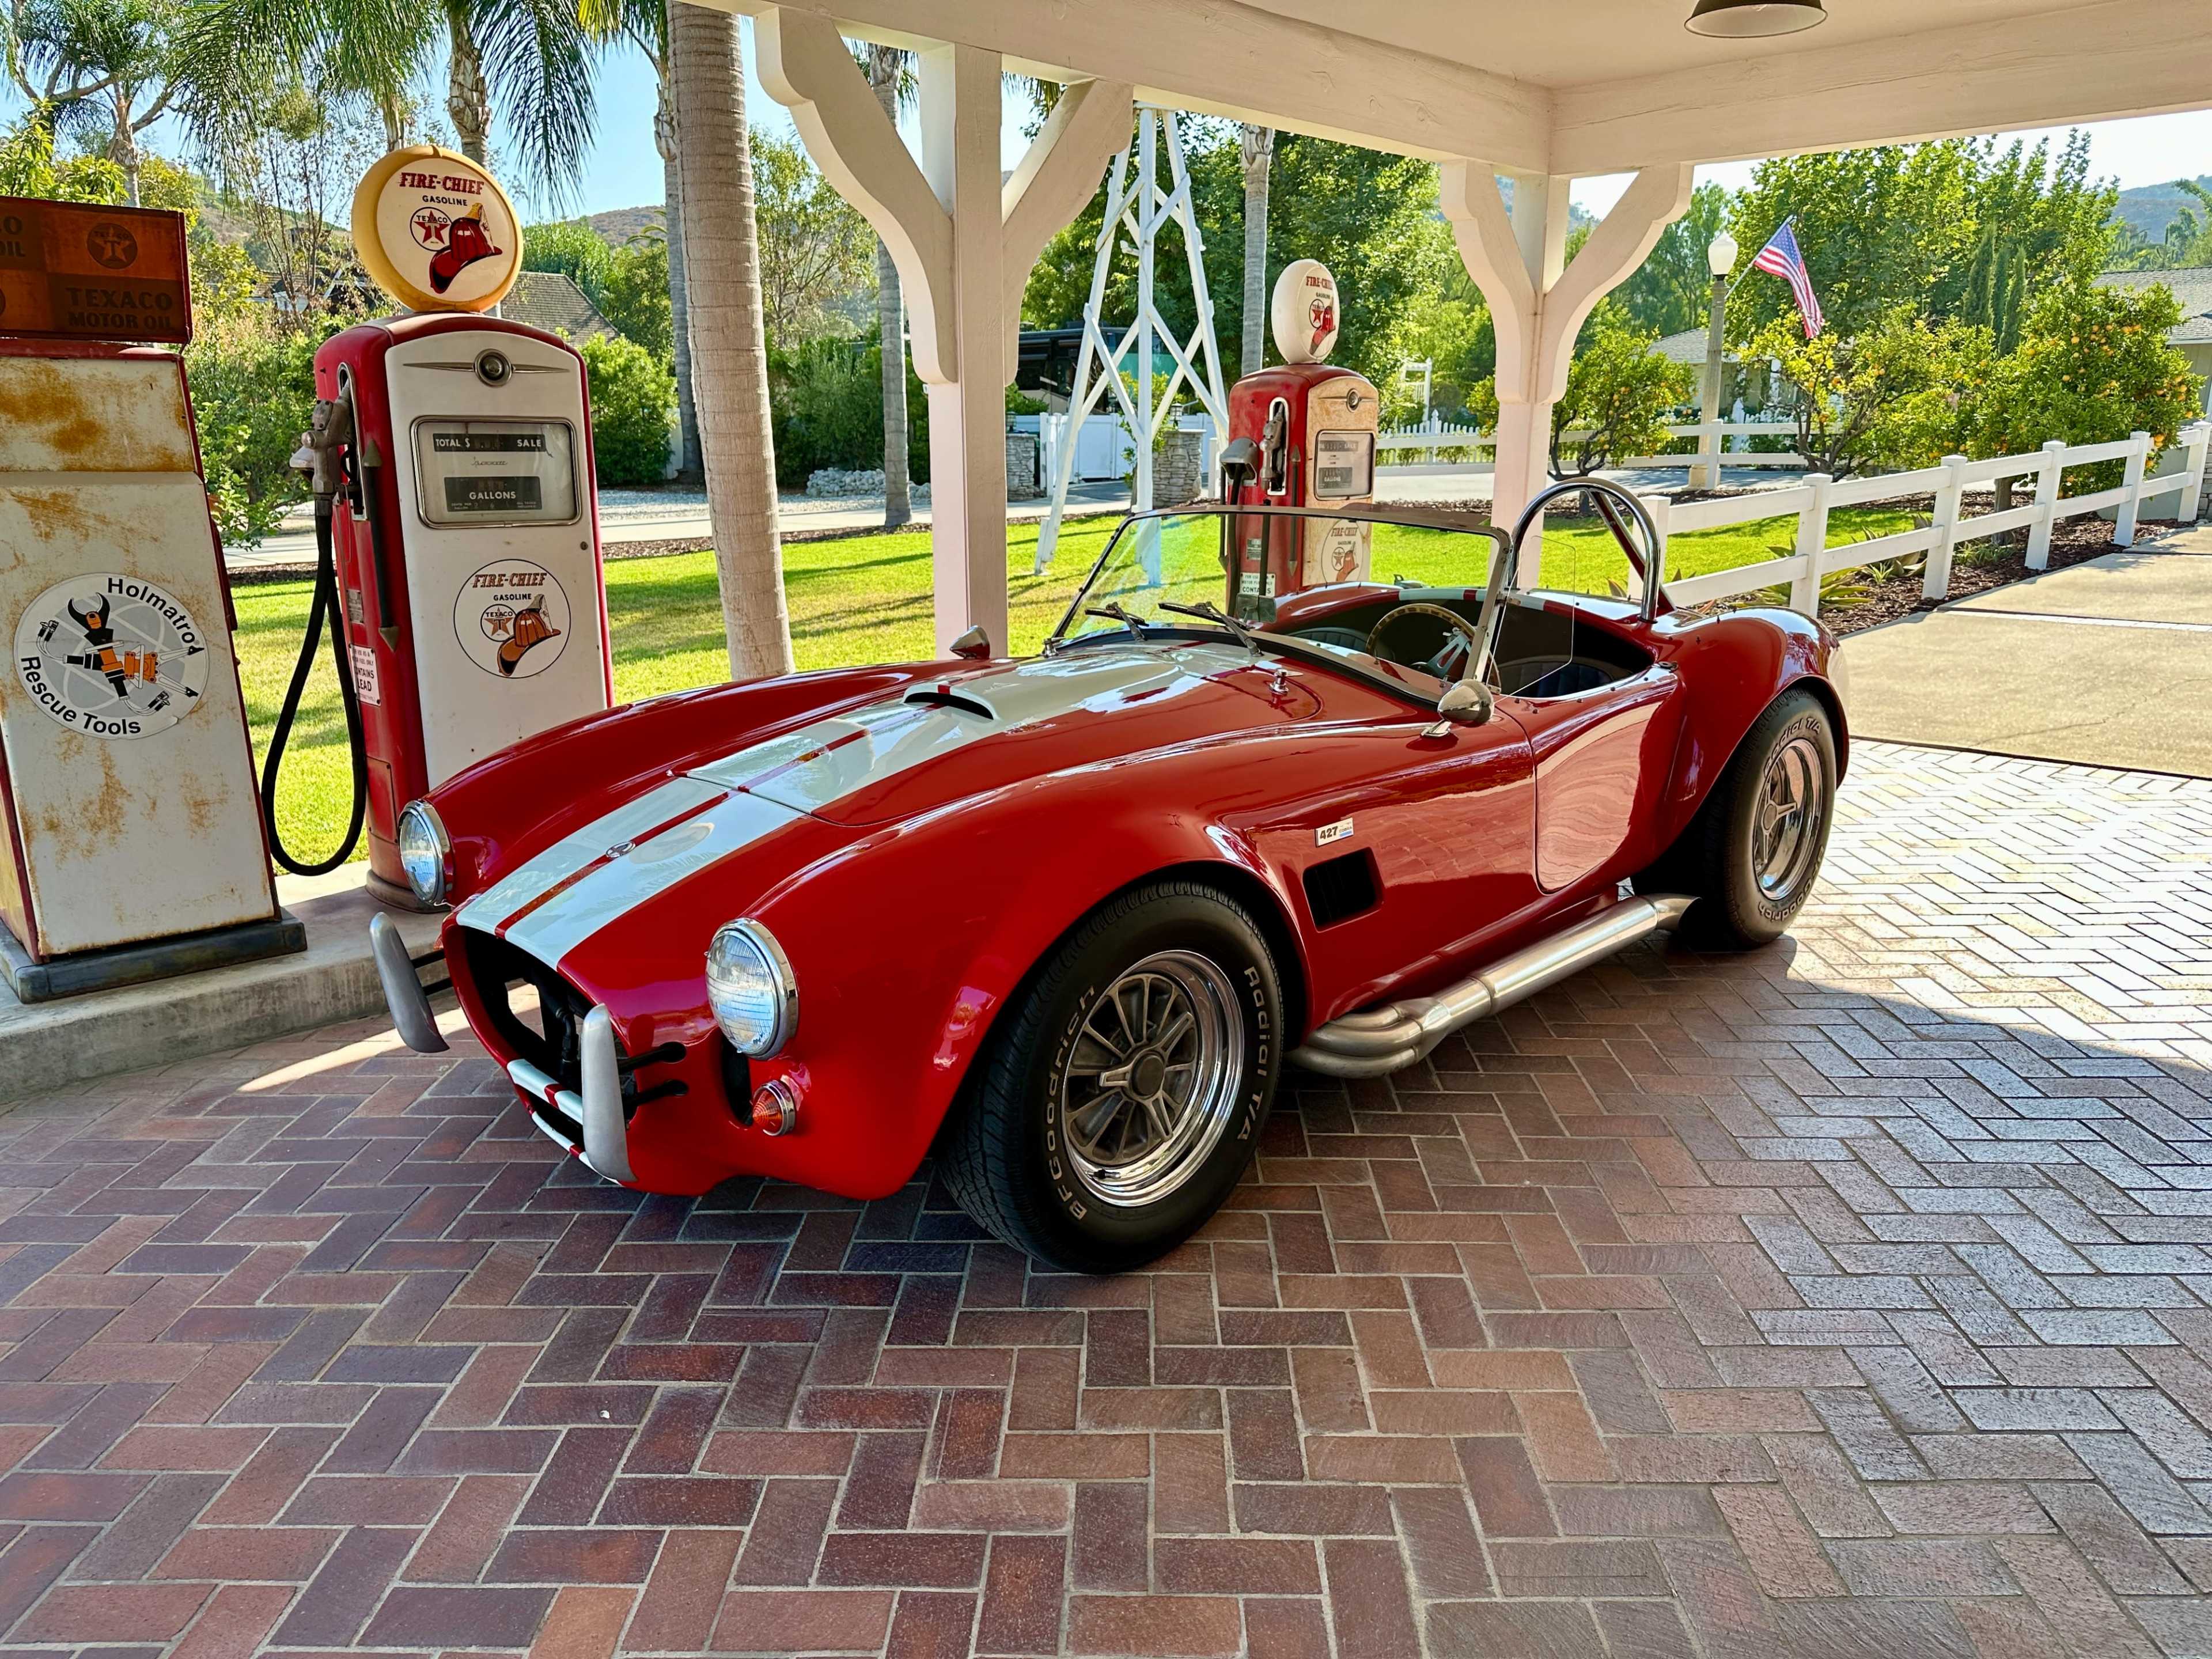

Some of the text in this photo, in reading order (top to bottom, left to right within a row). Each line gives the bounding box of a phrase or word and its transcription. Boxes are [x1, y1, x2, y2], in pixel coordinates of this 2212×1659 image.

[399, 172, 484, 195] FIRE-CHIEF
[422, 195, 468, 206] GASOLINE
[416, 215, 448, 224] TEXACO
[66, 288, 173, 311] TEXACO
[68, 311, 173, 331] MOTOR OIL
[435, 438, 542, 448] TOTAL $ SALE
[469, 491, 517, 500] GALLONS
[472, 573, 547, 588] FIRE-CHIEF
[493, 593, 532, 601] GASOLINE
[107, 577, 196, 643] Holmatro
[358, 677, 372, 692] LEAD
[21, 656, 141, 735] Rescue Tools
[1320, 825, 1338, 839] 427
[1237, 966, 1271, 1141] Radial T/A
